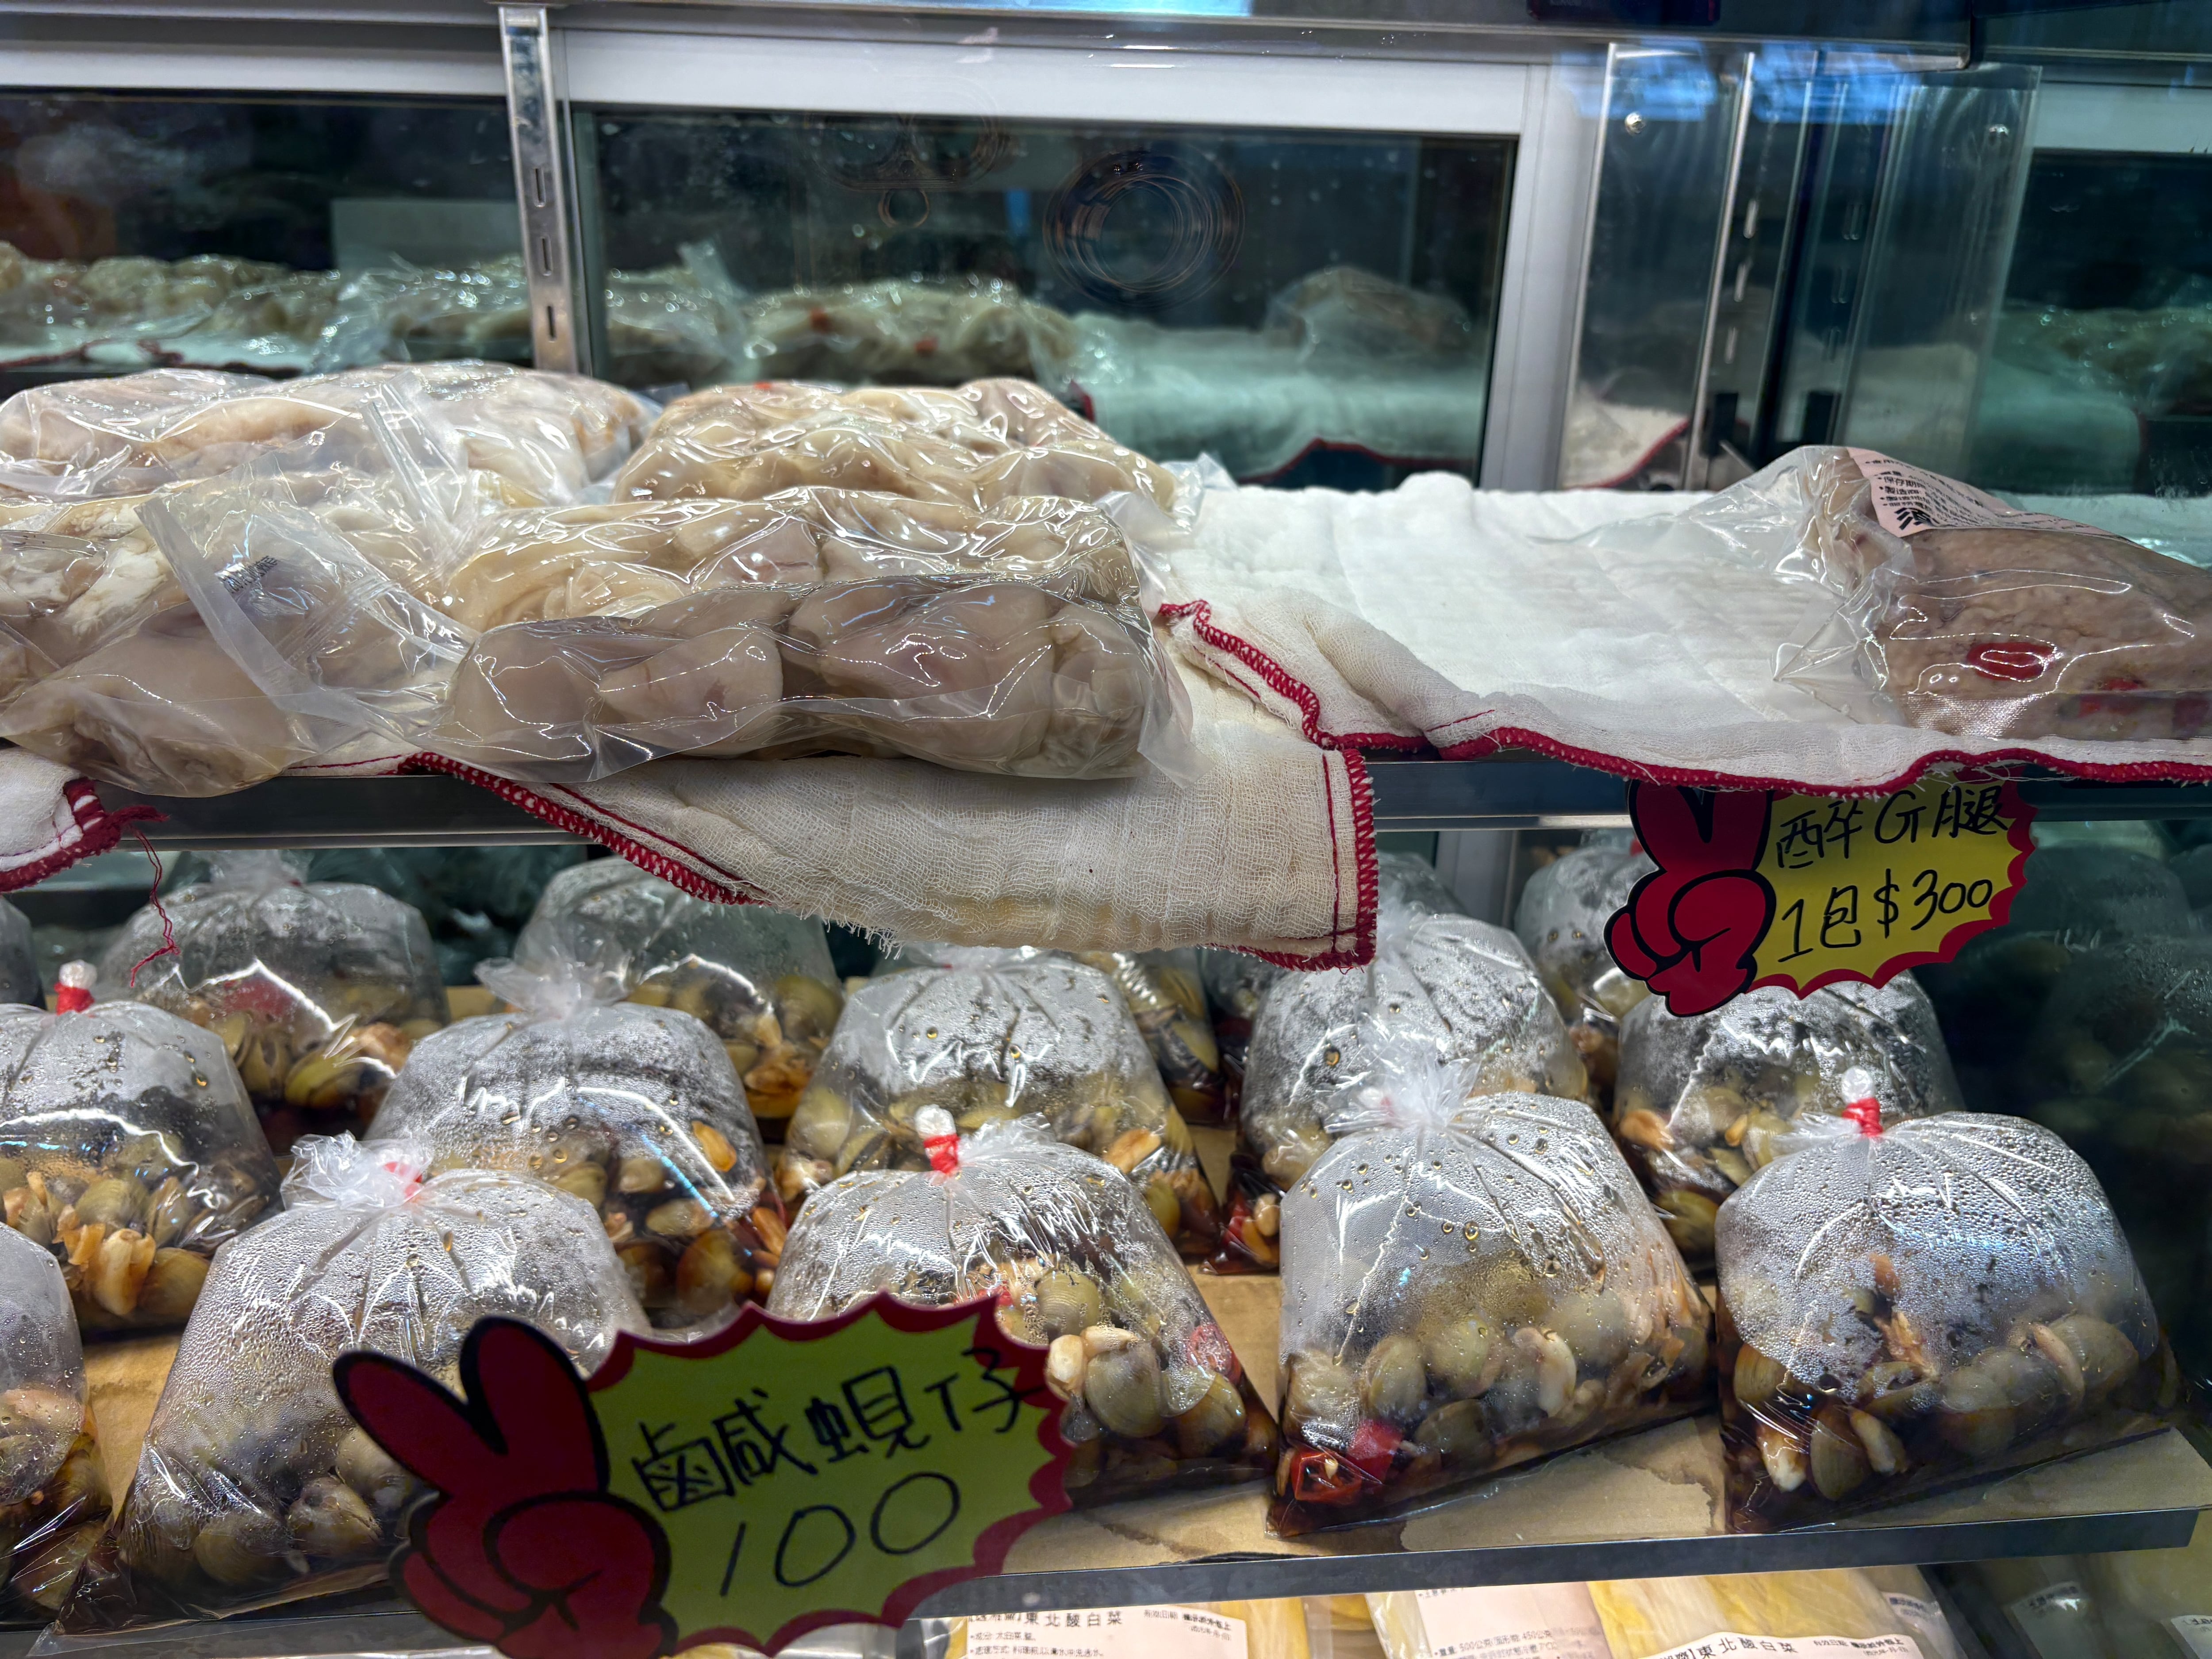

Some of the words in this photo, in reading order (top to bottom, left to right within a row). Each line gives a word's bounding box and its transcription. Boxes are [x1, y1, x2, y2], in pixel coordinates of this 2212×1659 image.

[1776, 784, 2010, 869] 醉G腿
[1777, 868, 1994, 962] 1包$300
[720, 1471, 961, 1596] 100
